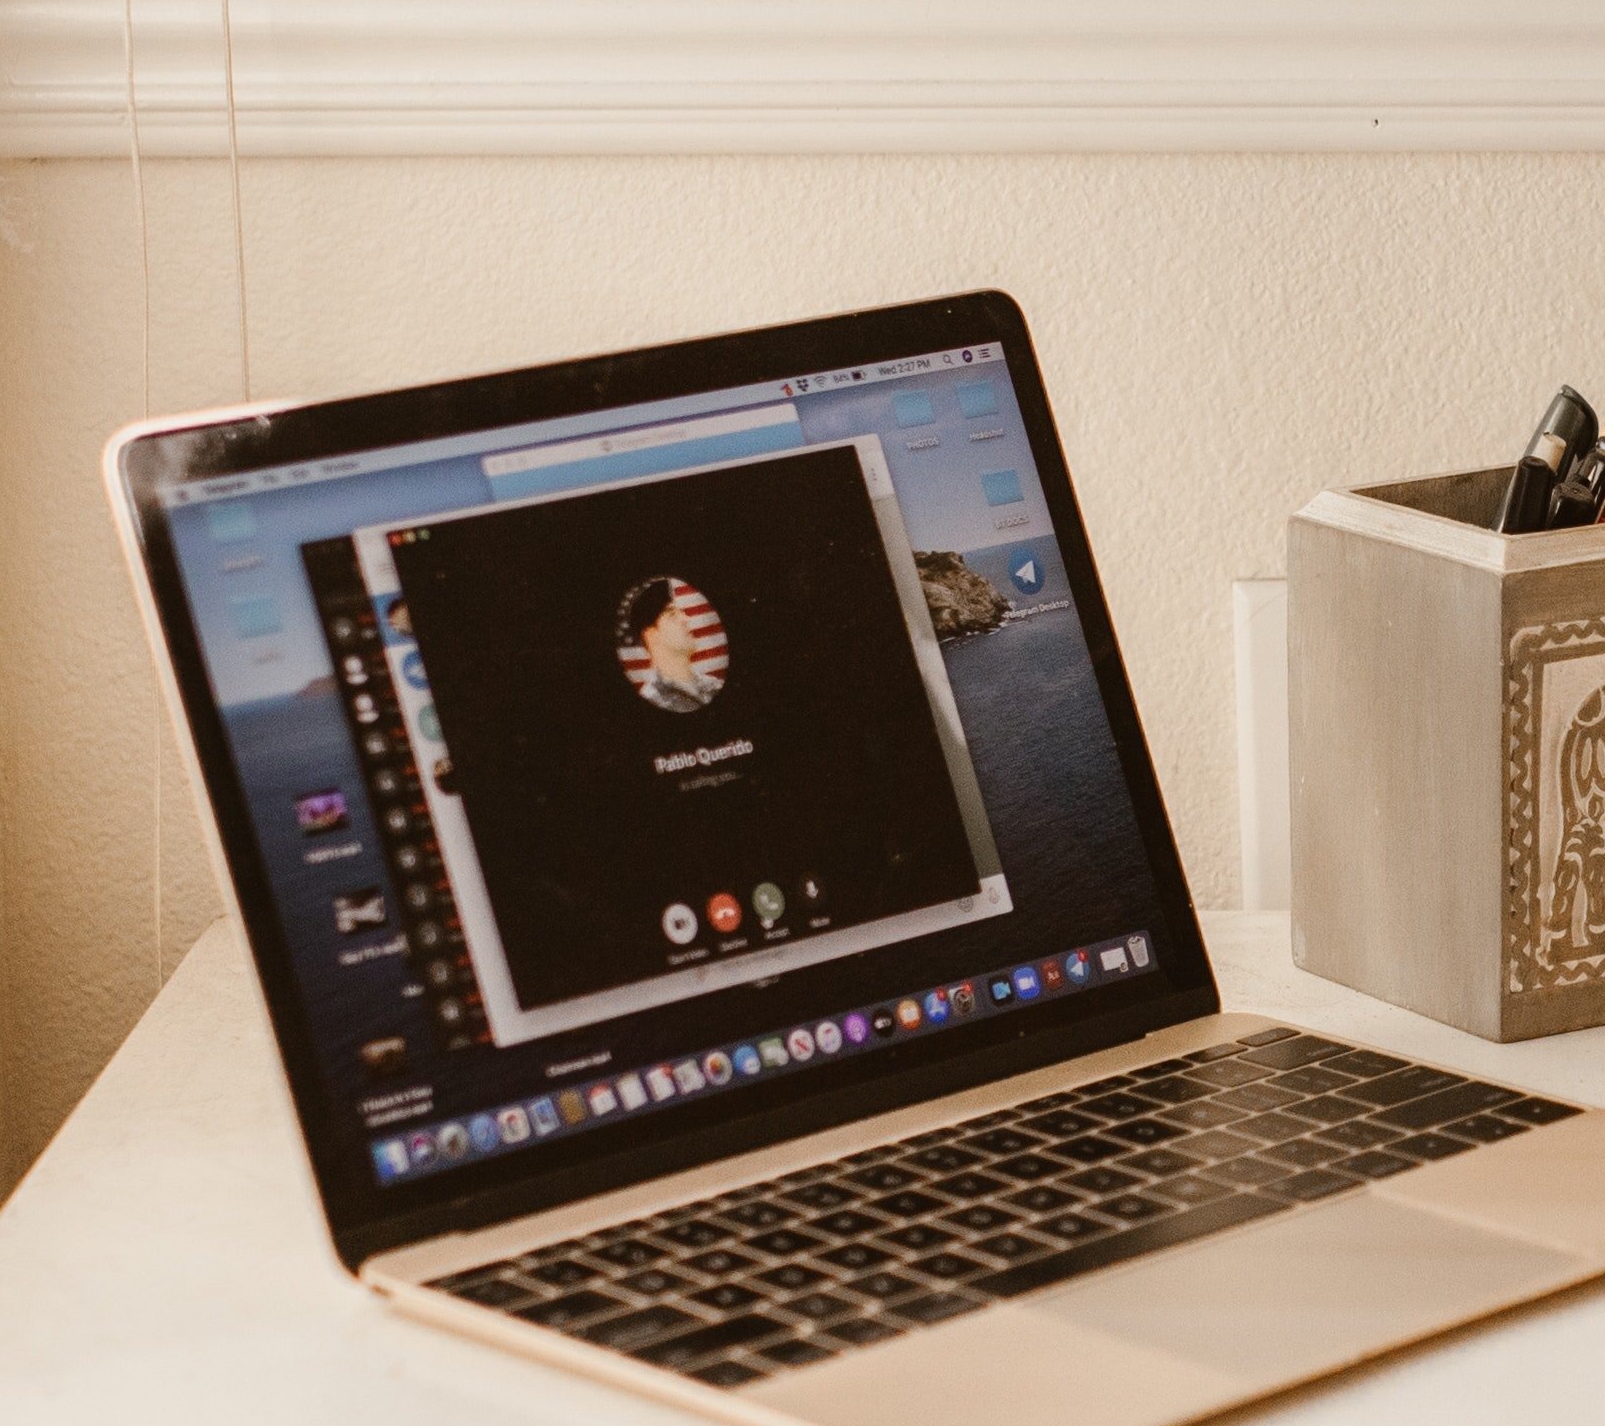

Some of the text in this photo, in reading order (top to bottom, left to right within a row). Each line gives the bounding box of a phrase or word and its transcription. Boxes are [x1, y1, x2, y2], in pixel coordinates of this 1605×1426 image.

[897, 361, 916, 373] 2:27
[916, 358, 932, 370] PM
[1039, 599, 1070, 614] Desktop
[654, 739, 754, 773] Pablo Querido
